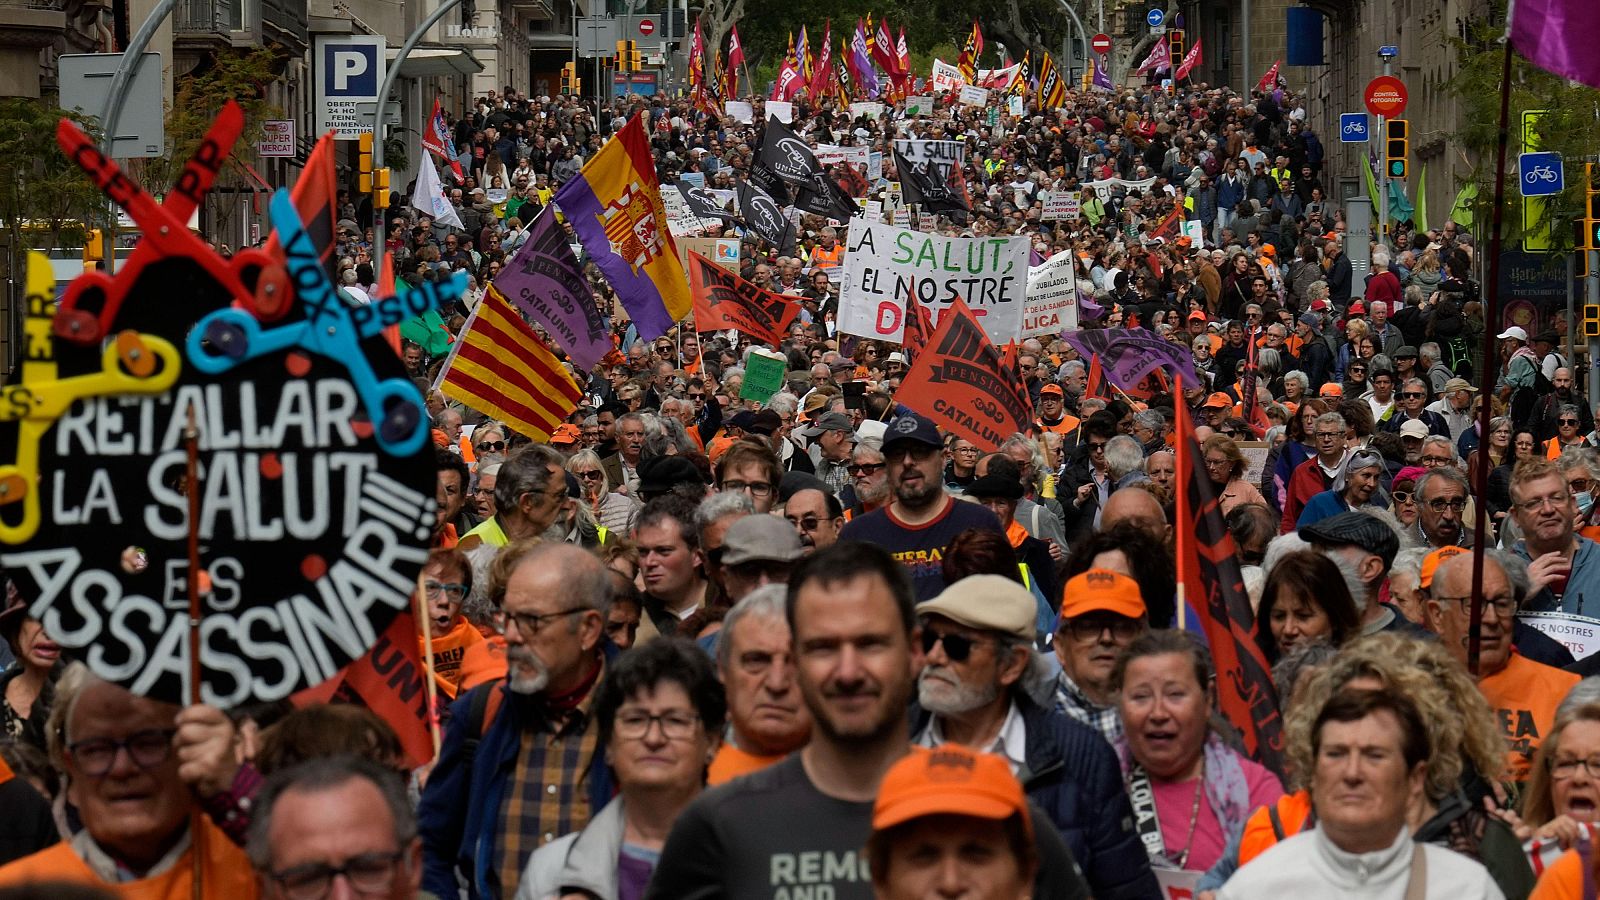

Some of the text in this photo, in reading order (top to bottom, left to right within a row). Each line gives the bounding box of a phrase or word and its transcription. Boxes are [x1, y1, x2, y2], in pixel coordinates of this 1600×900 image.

[334, 51, 368, 90] P
[261, 144, 292, 152] MERCAT
[262, 134, 291, 143] SUPER
[923, 141, 965, 161] SALUT
[891, 231, 1014, 275] SALUT,
[861, 267, 1015, 305] EL NOSTRE
[1035, 277, 1069, 290] JUBILADOS
[1046, 288, 1075, 299] LLOBREGAT
[1030, 306, 1039, 314] DE
[1039, 304, 1048, 312] LA
[1048, 298, 1075, 310] SANIDAD
[519, 286, 578, 349] CATALUNYA
[1022, 313, 1060, 331] LICA
[56, 377, 357, 458] RETALLAR
[933, 398, 1006, 449] CATALUN
[52, 450, 378, 542] LA SALUT
[1548, 623, 1594, 638] NOSTRES
